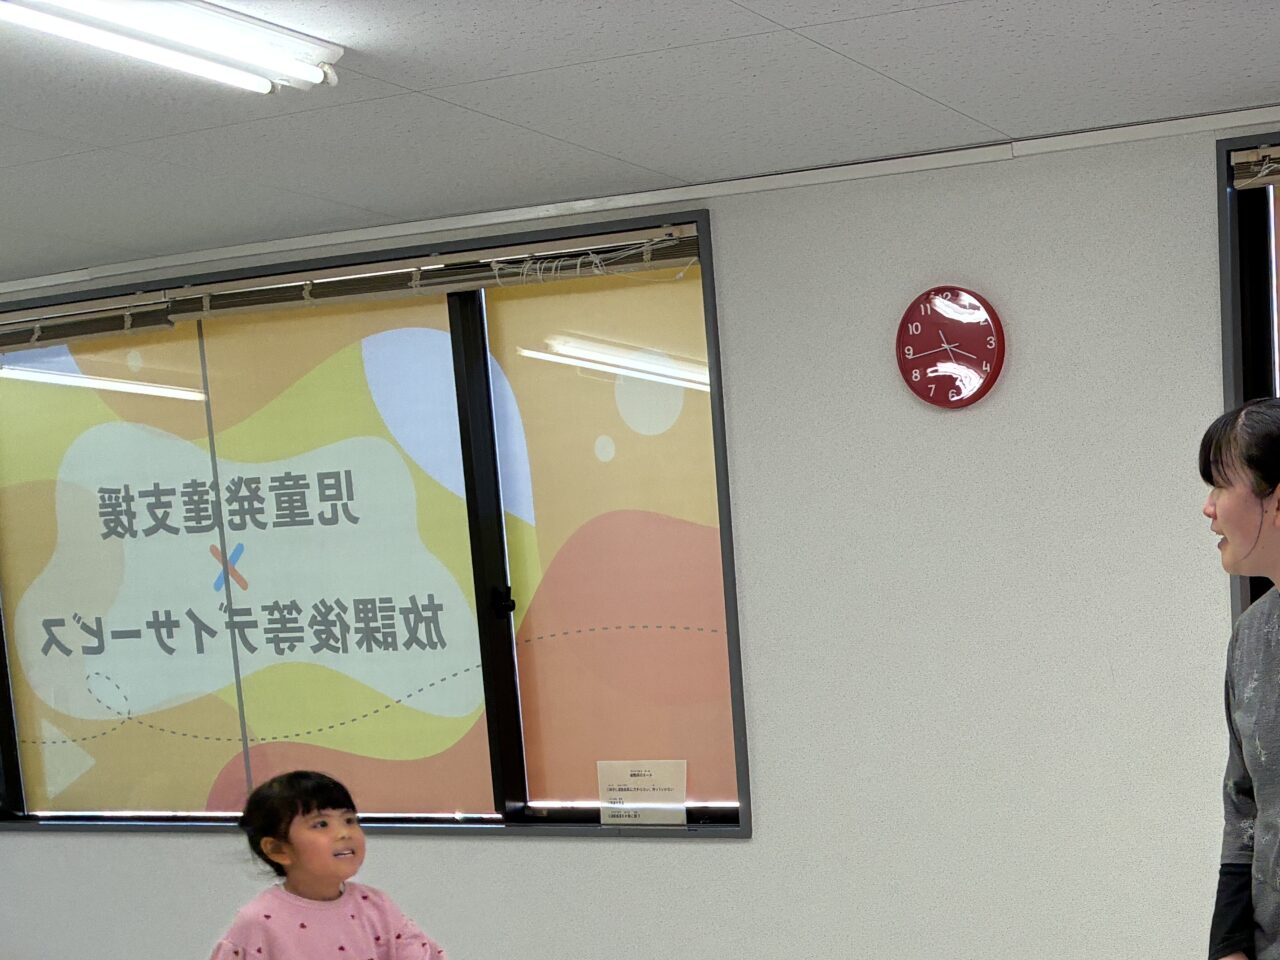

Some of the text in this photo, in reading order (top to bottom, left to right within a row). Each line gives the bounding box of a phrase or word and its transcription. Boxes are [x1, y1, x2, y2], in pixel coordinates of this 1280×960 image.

[920, 303, 931, 316] 11
[908, 322, 922, 335] 10
[986, 336, 996, 349] 3
[904, 346, 914, 358] 9
[982, 361, 991, 373] 4
[912, 369, 921, 382] 8
[927, 384, 936, 397] 7
[948, 389, 958, 400] 6
